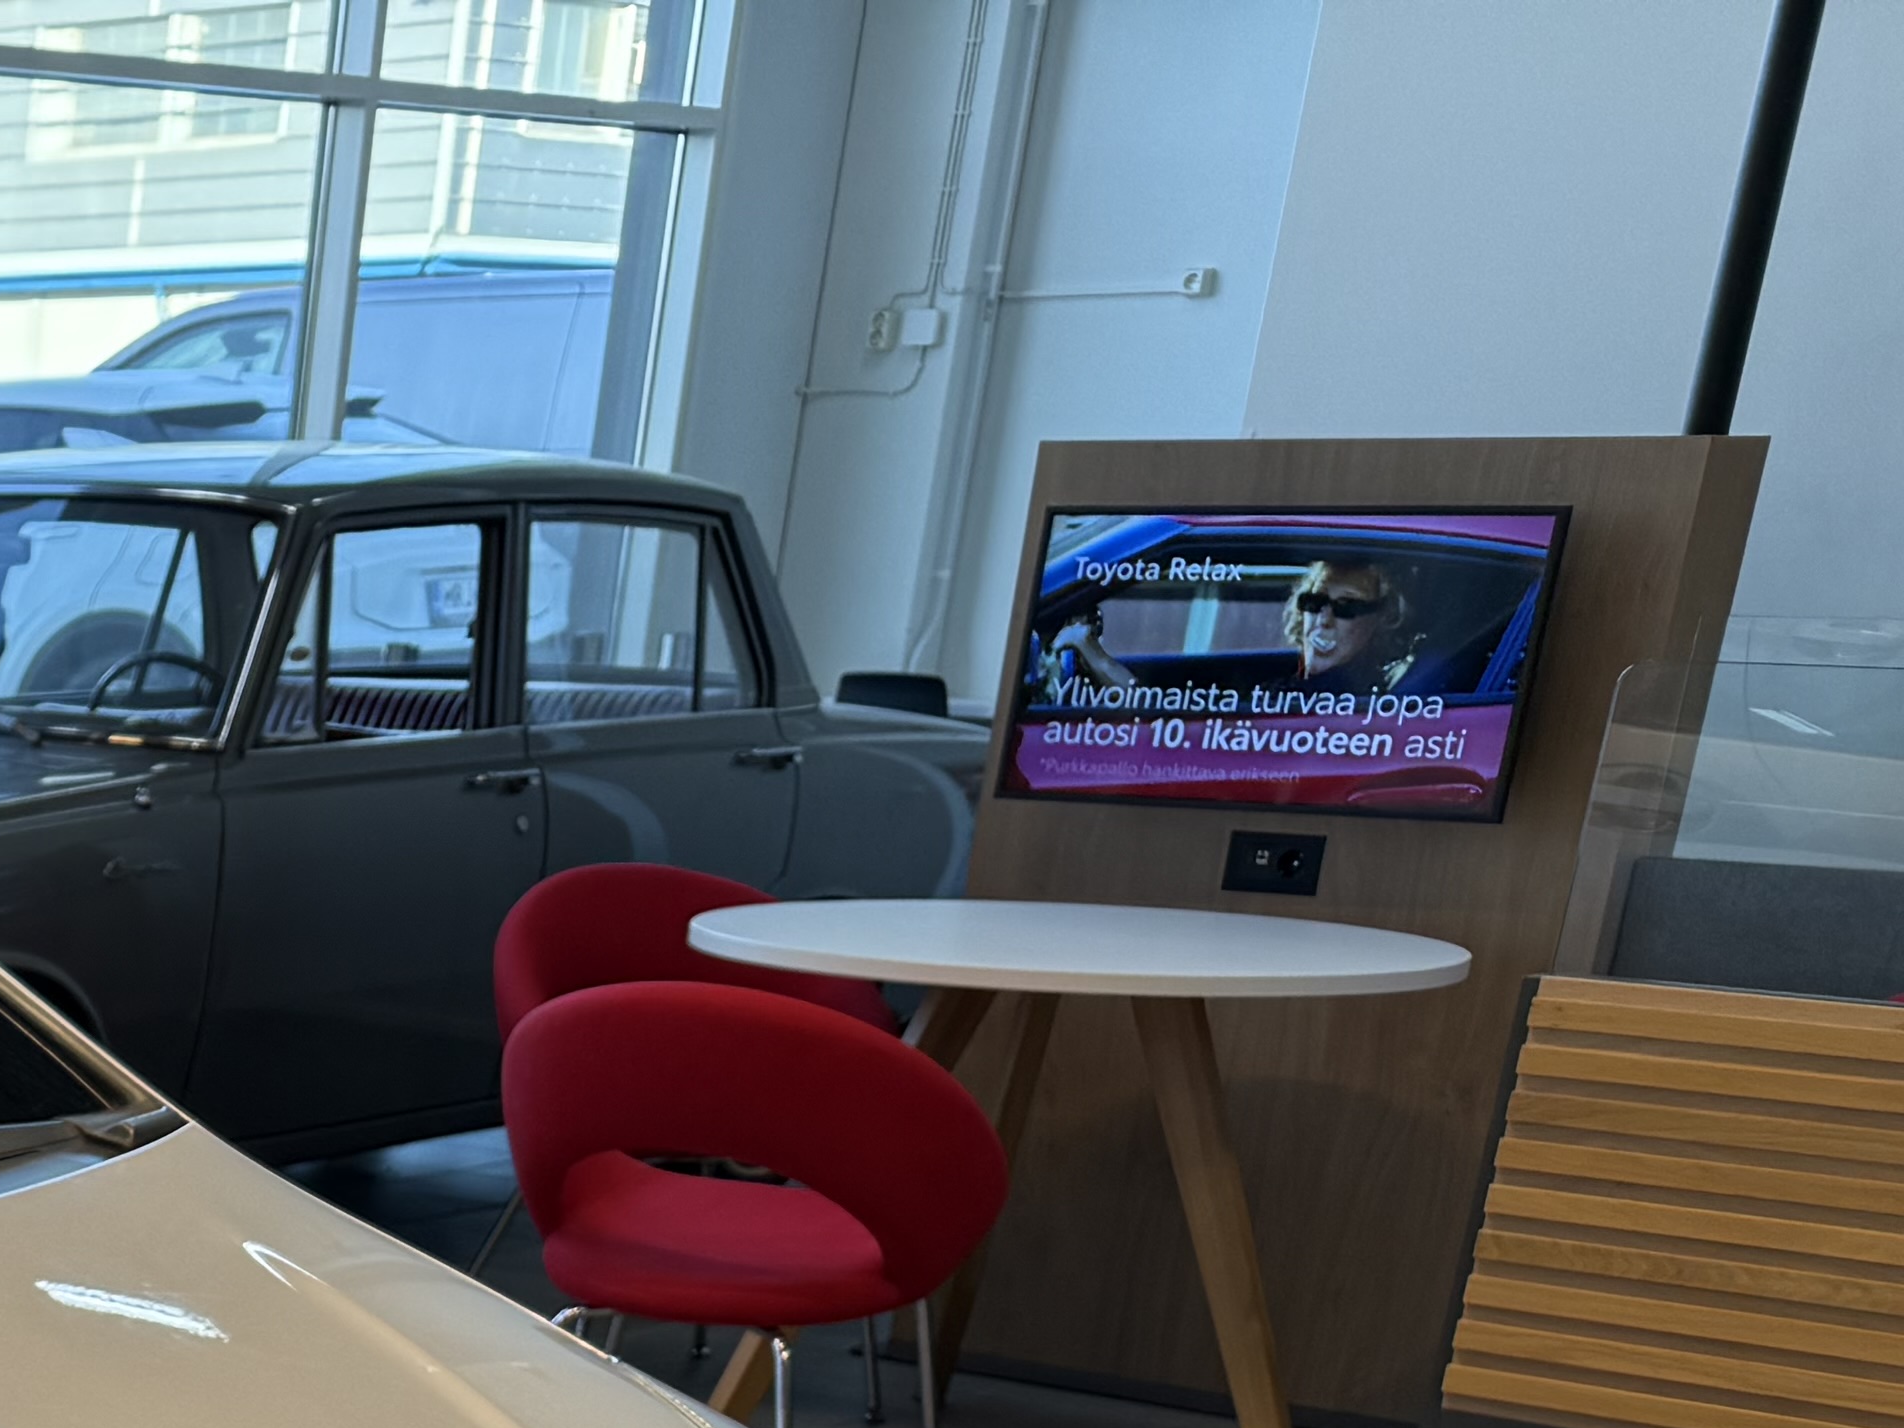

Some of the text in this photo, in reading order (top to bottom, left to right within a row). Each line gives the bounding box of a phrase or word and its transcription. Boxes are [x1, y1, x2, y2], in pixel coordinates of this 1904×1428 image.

[1075, 556, 1242, 586] Toyota Relax
[1053, 674, 1444, 726] Ylivoimaista turvaa jopa
[1043, 716, 1468, 760] autosi 10. ikävuoteen asti
